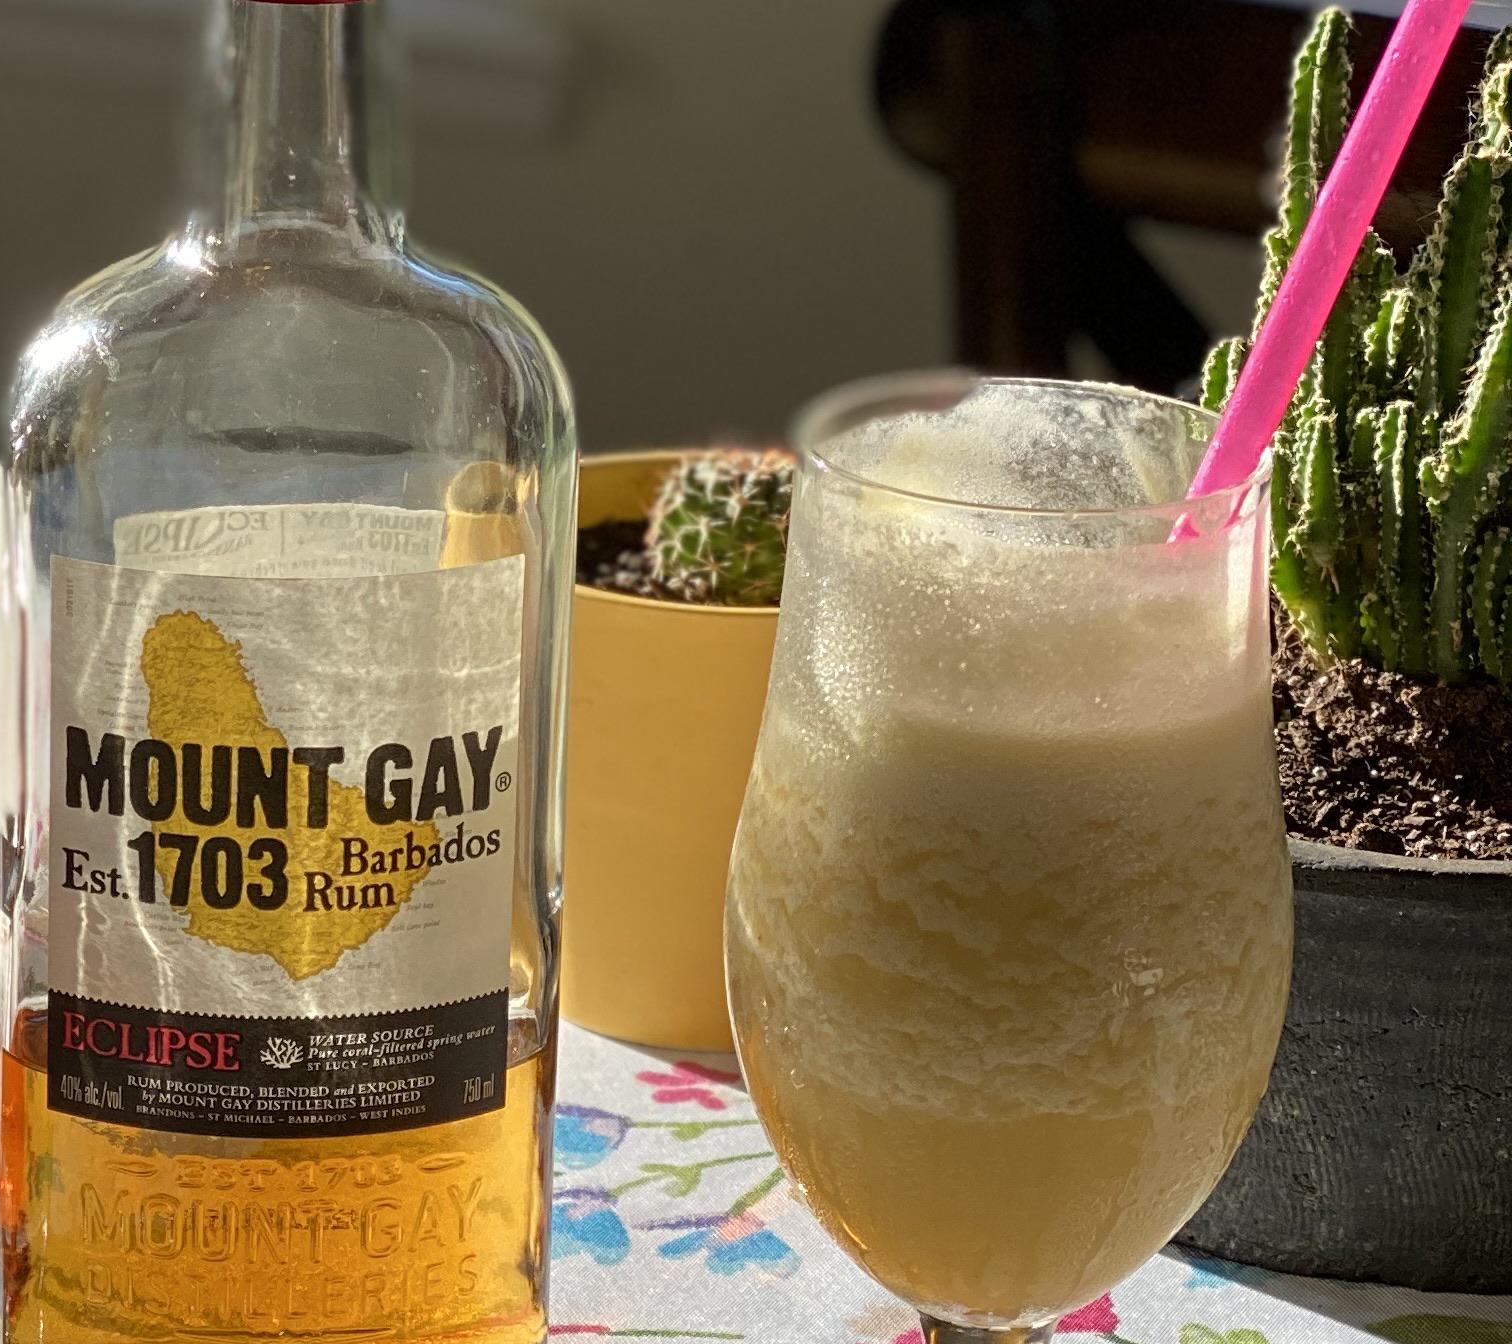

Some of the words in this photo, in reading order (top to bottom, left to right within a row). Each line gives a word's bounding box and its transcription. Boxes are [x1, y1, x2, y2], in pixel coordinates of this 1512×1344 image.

[66, 725, 345, 830] MOUNT
[62, 847, 130, 900] Est.
[127, 830, 289, 912] 1703
[340, 822, 501, 877] Barbados
[303, 870, 397, 912] Rum
[63, 1010, 241, 1071] ECLIPSE
[308, 1047, 339, 1059] Pure
[342, 1039, 425, 1058] coral-filtered
[426, 1032, 464, 1050] spring
[466, 1024, 496, 1041] water
[309, 1033, 367, 1047] WATER
[371, 1024, 435, 1044] SOURCE
[307, 1061, 322, 1072] ST
[326, 1059, 358, 1072] LUCY
[373, 1050, 435, 1068] BARBADOS
[60, 1074, 83, 1102] 40%
[127, 1074, 162, 1091] RUM
[167, 1080, 254, 1099] PRODUCED,
[259, 1086, 330, 1099] BLENDED
[334, 1083, 354, 1097] and
[358, 1075, 436, 1095] EXPORTED
[142, 1091, 155, 1105] by
[159, 1093, 219, 1108] MOUNT
[222, 1099, 255, 1111] GAY
[257, 1096, 358, 1112] DISTILLERIES
[361, 1090, 421, 1108] LIMITED
[463, 1076, 481, 1105] 750
[483, 1072, 495, 1099] ml
[136, 1105, 196, 1120] BRANDONS
[207, 1112, 221, 1122] ST
[224, 1113, 275, 1125] MICHAEL
[288, 1113, 348, 1125] BARBADOS
[359, 1109, 388, 1121] WEST
[391, 1104, 427, 1117] INDIES
[79, 1182, 342, 1265] MOUNT
[359, 1176, 484, 1258] GAY
